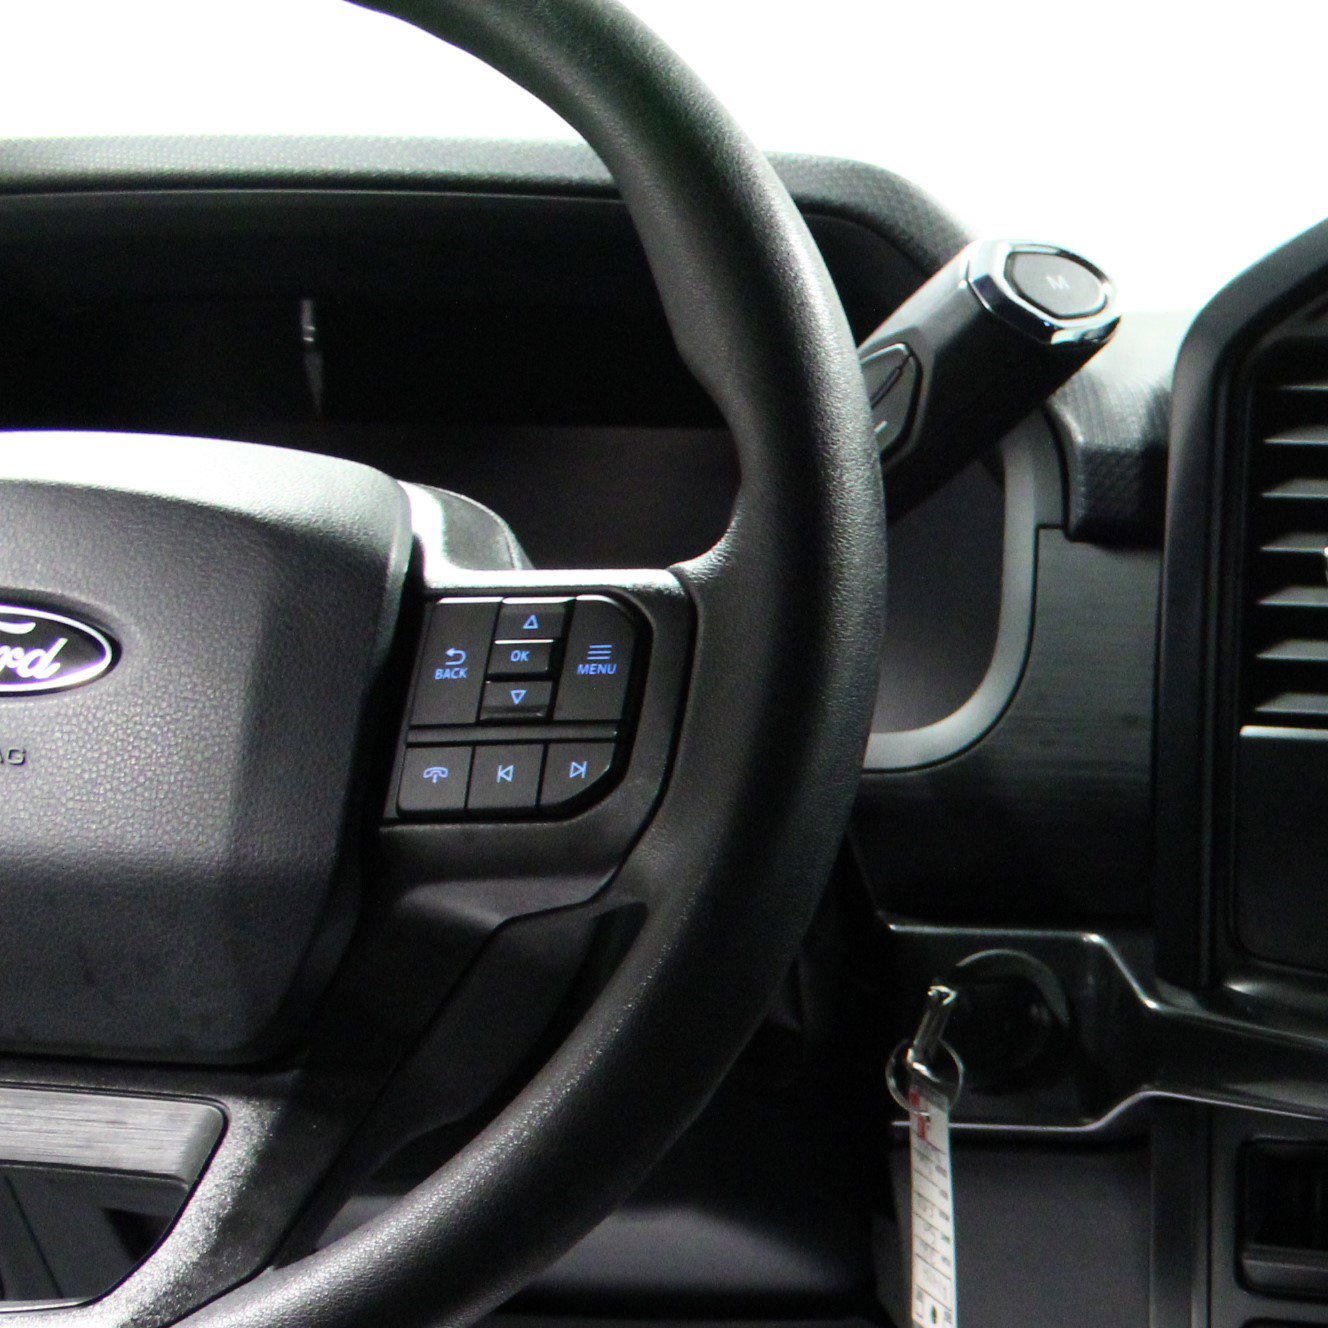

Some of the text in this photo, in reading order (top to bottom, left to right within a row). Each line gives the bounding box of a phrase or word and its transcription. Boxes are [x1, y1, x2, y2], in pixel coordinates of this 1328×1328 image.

[511, 650, 530, 662] OK
[434, 667, 468, 680] BACK
[577, 663, 617, 675] MENU
